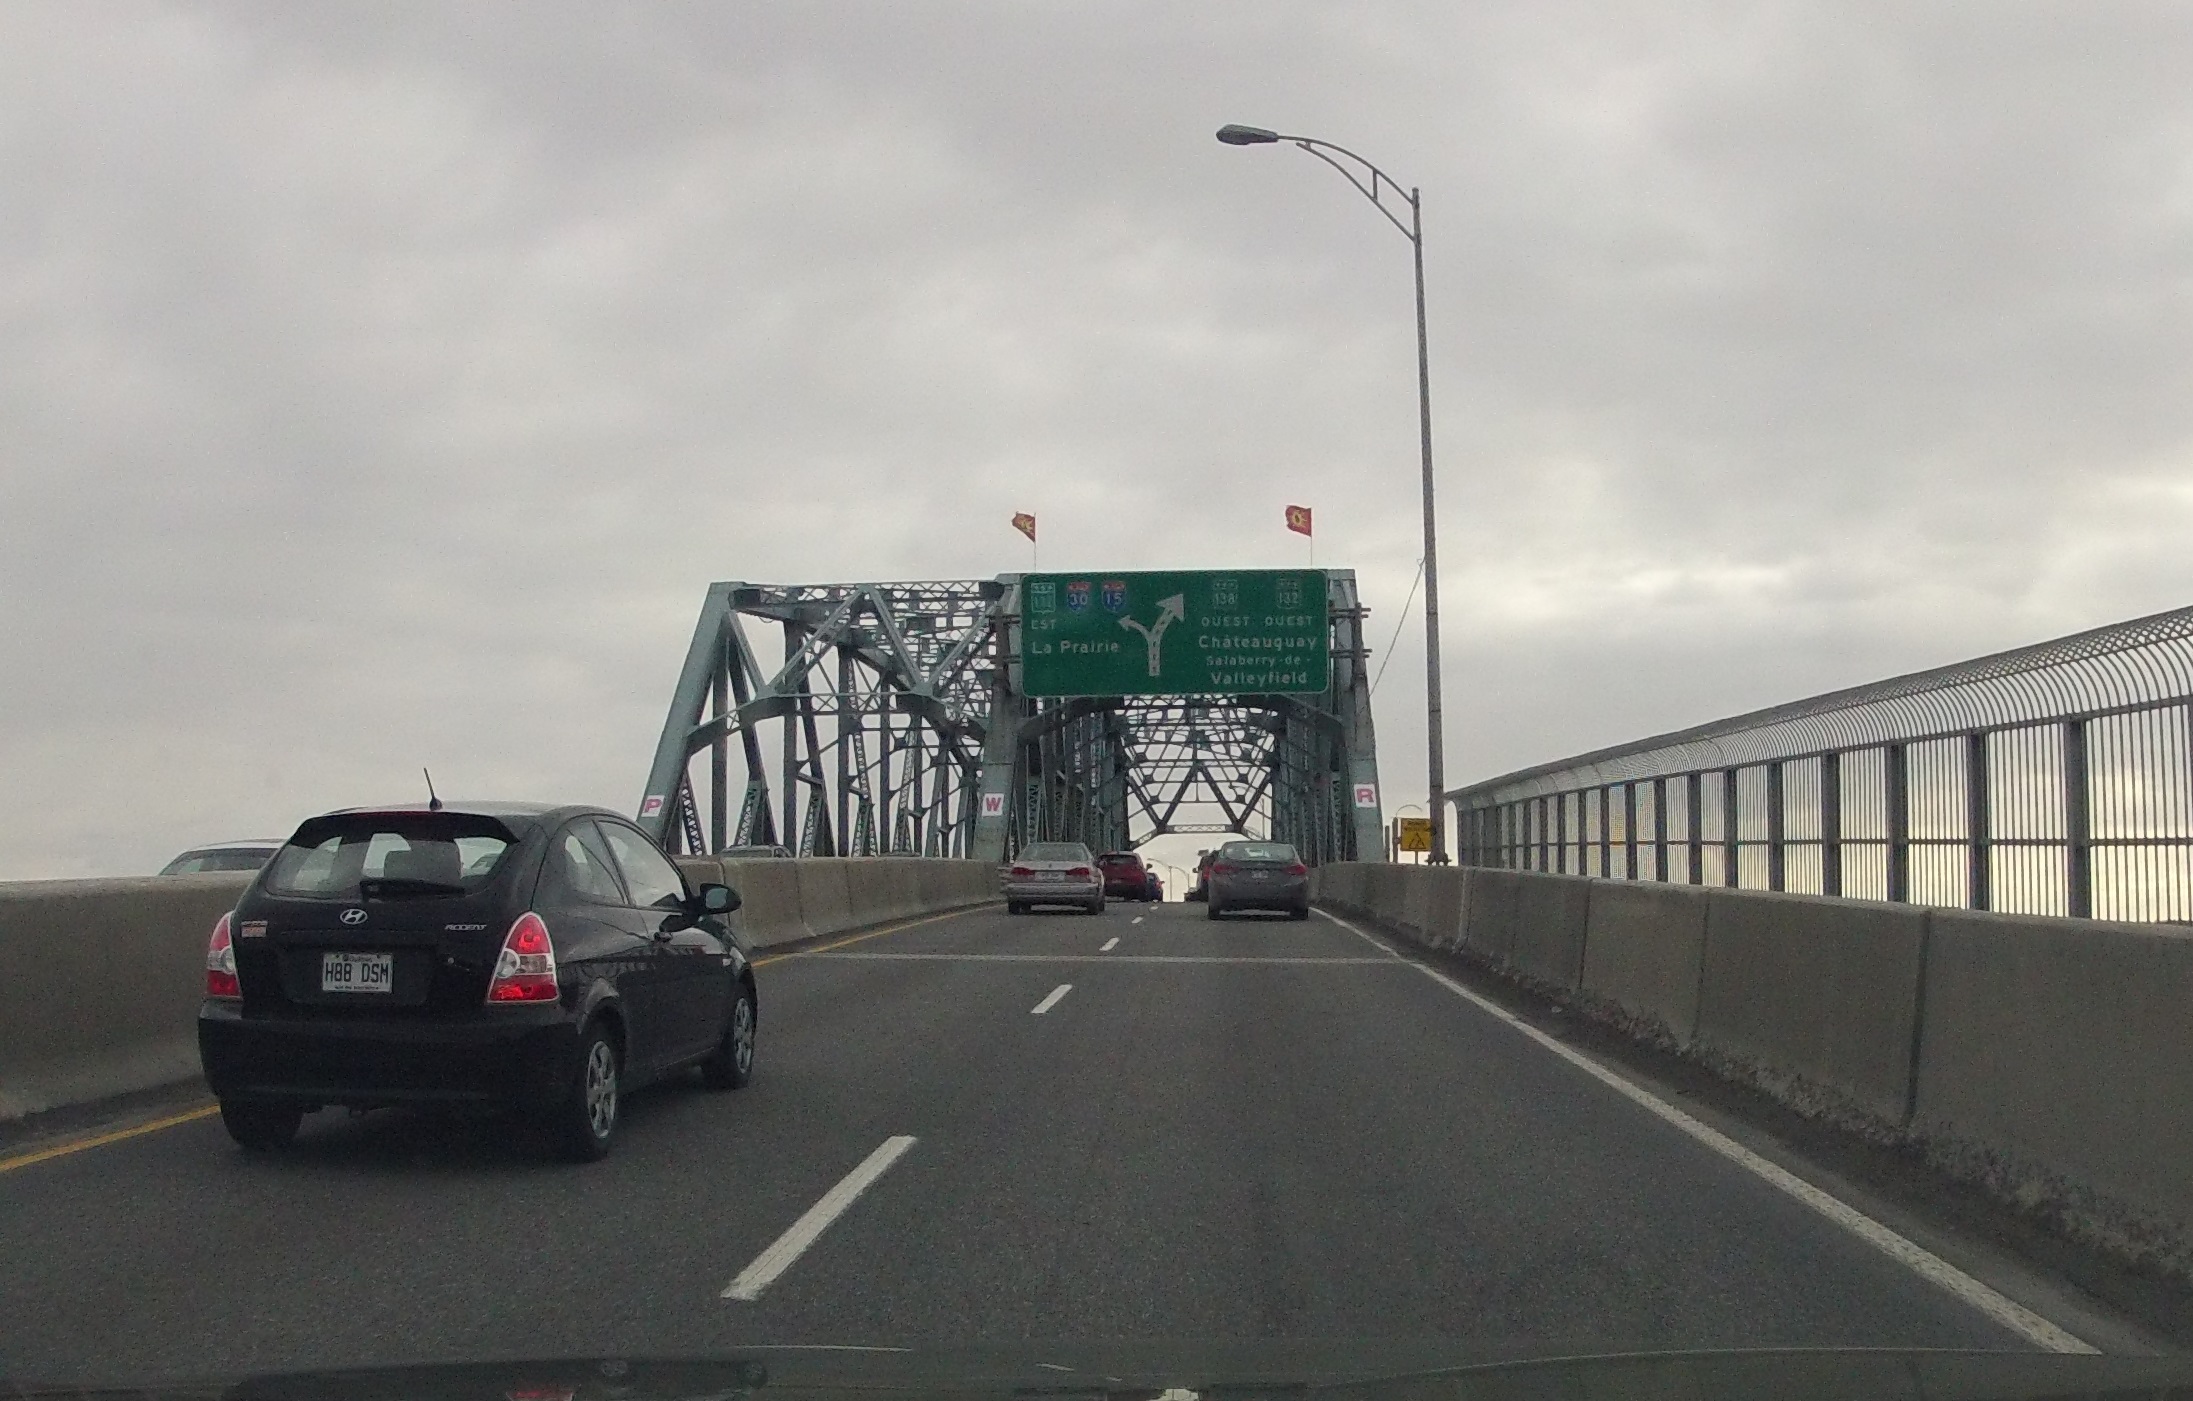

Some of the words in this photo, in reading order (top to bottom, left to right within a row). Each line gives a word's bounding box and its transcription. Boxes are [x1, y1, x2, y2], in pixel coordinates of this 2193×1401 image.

[1069, 593, 1089, 606] 30
[1105, 592, 1123, 606] 15
[1031, 619, 1057, 630] EST
[1201, 616, 1250, 627] OUEST
[1264, 616, 1314, 627] OUEST
[1031, 641, 1053, 654] La
[1060, 640, 1119, 654] Prairie
[1210, 671, 1308, 688] Valleyfield
[1356, 788, 1375, 803] R
[643, 798, 663, 813] P
[985, 797, 1002, 811] W
[325, 962, 352, 982] H88
[361, 962, 389, 983] DSM
